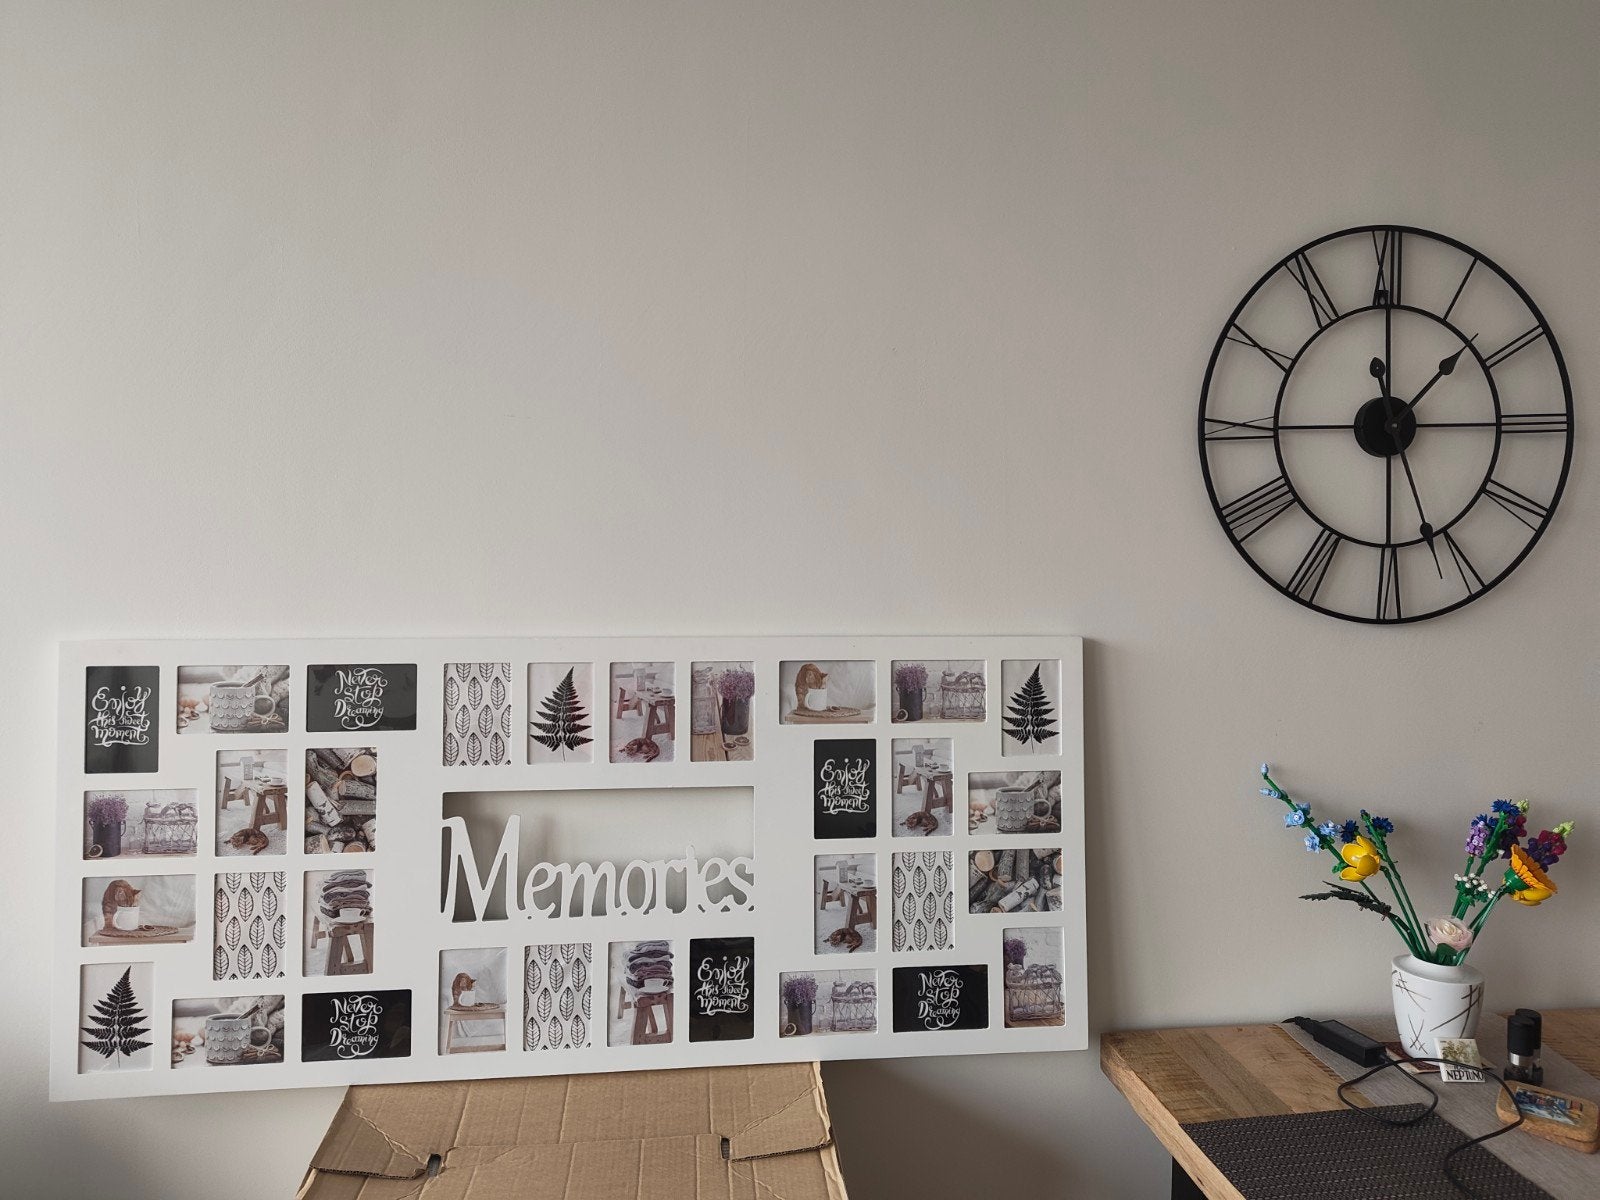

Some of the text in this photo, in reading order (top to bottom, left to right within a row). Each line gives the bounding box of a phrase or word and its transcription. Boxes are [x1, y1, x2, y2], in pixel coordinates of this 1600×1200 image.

[334, 668, 388, 695] Never
[91, 685, 152, 721] Enjoy
[333, 698, 384, 730] Dreaming
[88, 710, 151, 731] this sweet
[820, 758, 871, 791] Enjoy
[817, 780, 870, 800] this sweet
[441, 813, 755, 922] Memories
[697, 955, 750, 991] Enjoy
[917, 969, 964, 997] Never
[693, 980, 750, 1000] this sweet
[329, 994, 383, 1024] Never
[917, 1000, 961, 1030] Dreaming
[329, 1027, 380, 1058] Dreaming
